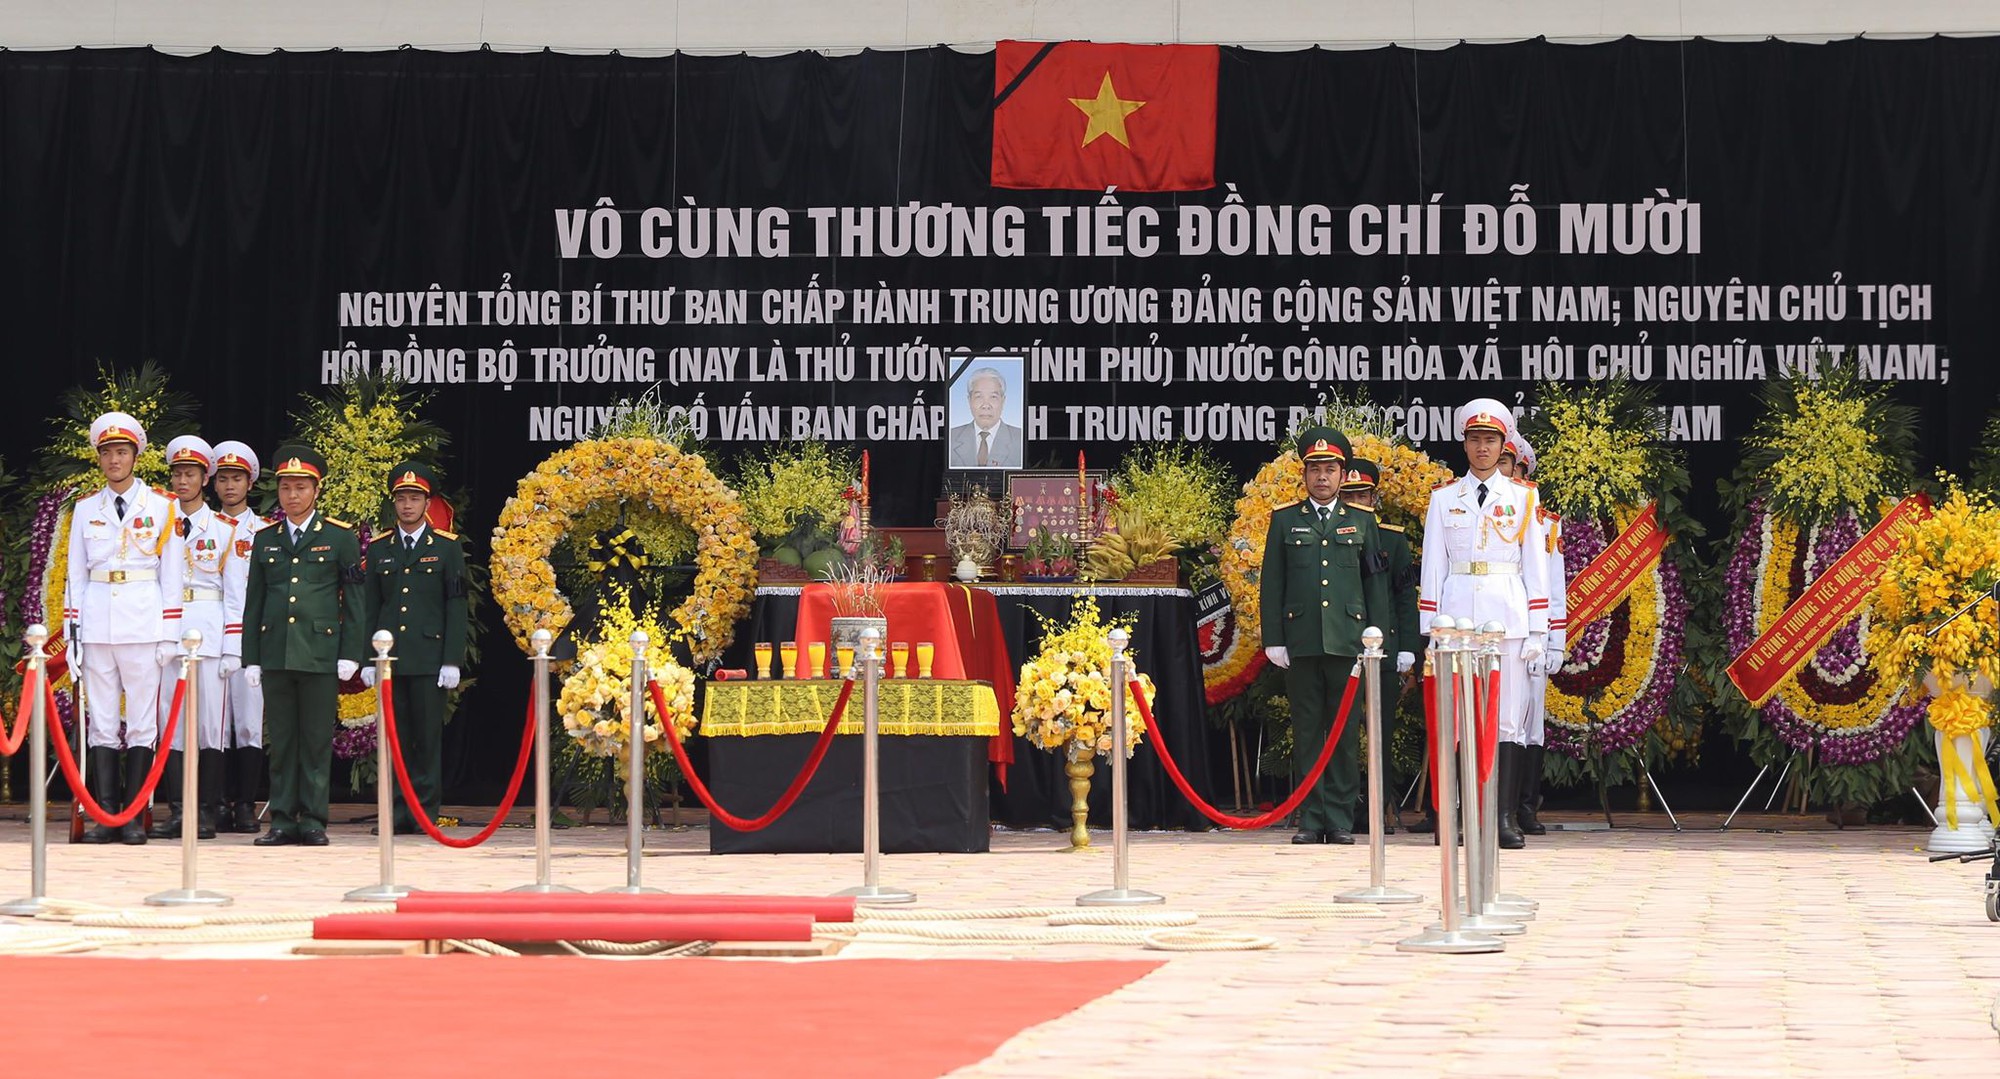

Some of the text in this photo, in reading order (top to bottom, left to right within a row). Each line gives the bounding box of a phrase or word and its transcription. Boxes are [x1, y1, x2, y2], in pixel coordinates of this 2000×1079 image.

[555, 183, 1700, 258] VÔ CÙNG THƯƠNG TIẾC ĐỒNG CHÍ ĐỖ MƯỜI
[340, 271, 1931, 331] NGUYÊN TỔNG BÍ THƯ BAN CHẤP HÀNH TRUNG ƯƠNG ĐẢNG CỘNG SẢN VIỆT NAM; NGUYÊN CHỦ TỊCH
[381, 334, 465, 384] ĐỒNG
[478, 340, 517, 391] BỘ
[531, 334, 655, 383] TRƯỞNG
[669, 346, 740, 387] (NAY
[749, 338, 788, 381] LÀ
[796, 333, 855, 381] THỦ
[866, 336, 971, 382] TƯỚN
[990, 339, 1085, 382] ÍNH
[1101, 333, 1173, 386] PHỦ)
[1187, 334, 1273, 382] NƯỚC
[1283, 338, 1369, 391] CỘNG
[1382, 336, 1445, 381] HÒA
[1458, 337, 1502, 380] XÃ
[1588, 331, 1652, 381] CHỦ
[1667, 338, 1766, 380] NGHĨA
[1776, 336, 1845, 388] VIỆT
[1859, 345, 1949, 385] NAM;
[718, 391, 780, 441] VẤN
[791, 406, 855, 441] BAN
[867, 390, 944, 441] CHẤP
[1066, 406, 1172, 441] TRUNG
[1184, 403, 1275, 441] ƯƠNG
[1746, 651, 1765, 672] VÔ
[1759, 631, 1788, 660] CÙNG
[1783, 600, 1820, 637] THƯƠNG
[1814, 579, 1840, 605] TIẾC
[1834, 561, 1862, 587] ĐỒNG
